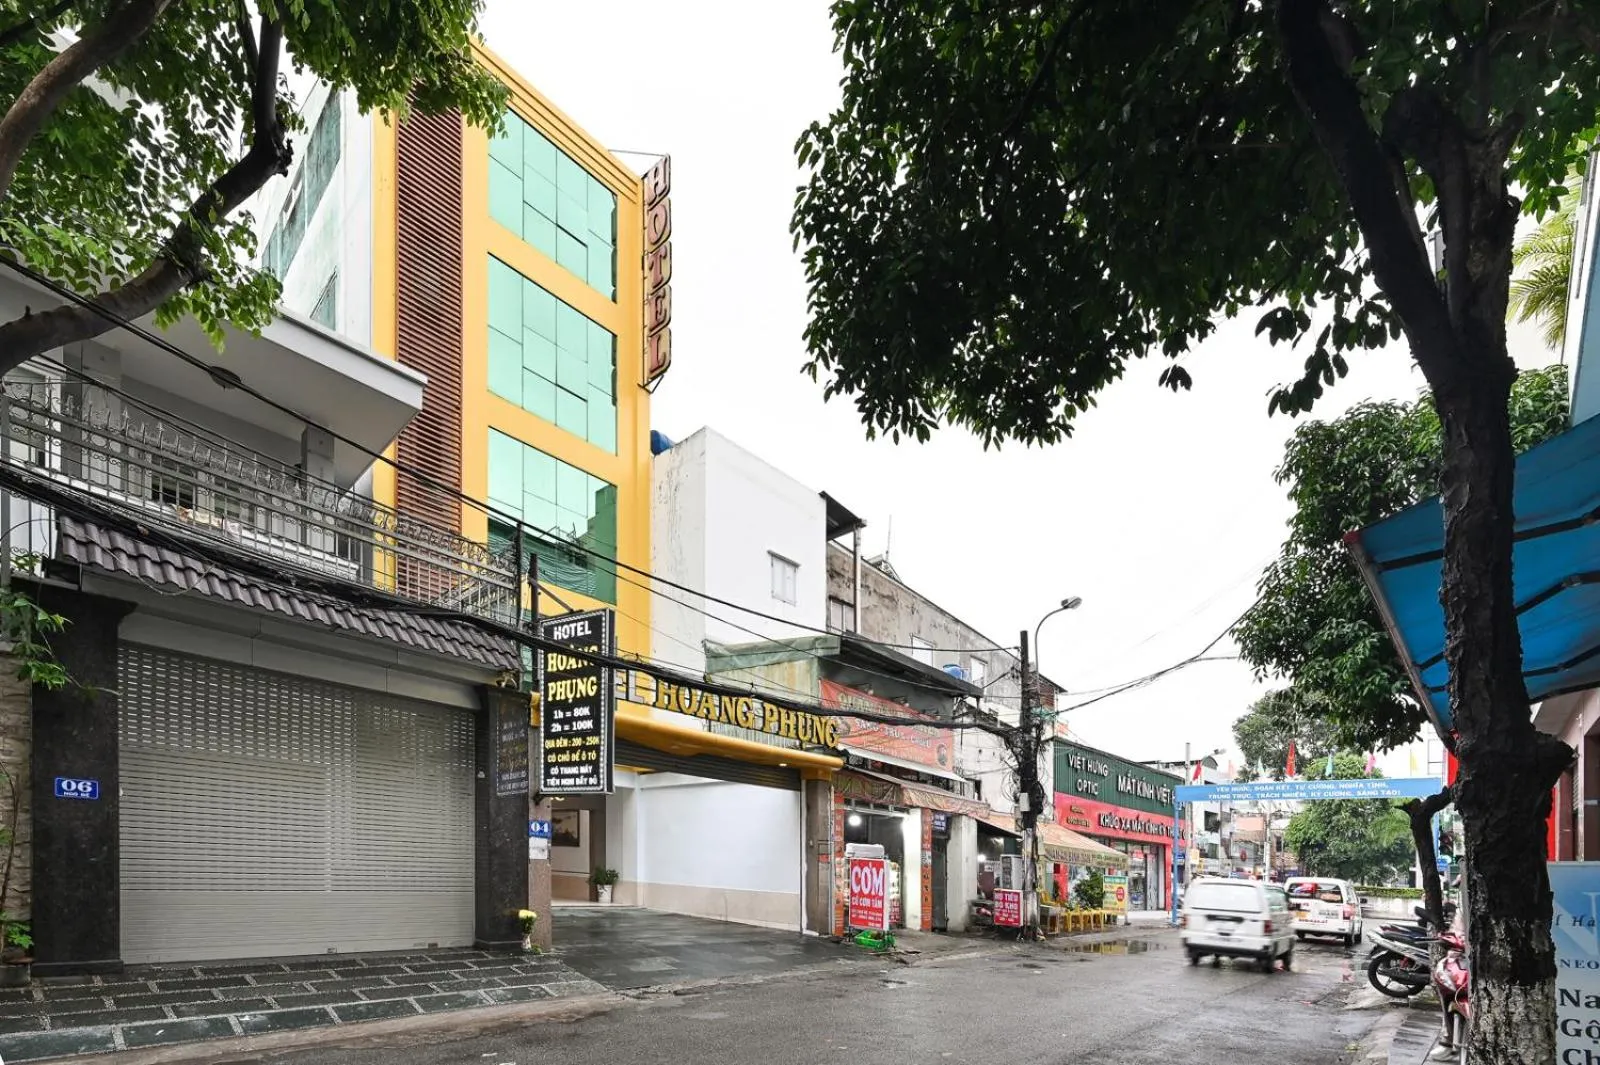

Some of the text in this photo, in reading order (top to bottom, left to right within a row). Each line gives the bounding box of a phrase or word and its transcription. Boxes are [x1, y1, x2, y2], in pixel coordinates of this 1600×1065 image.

[647, 156, 669, 374] HOTEL
[553, 620, 592, 641] HOTEL
[547, 676, 598, 704] PHỤNG
[553, 709, 564, 720] 1h
[573, 706, 591, 718] 80K
[550, 722, 562, 733] 2h
[572, 719, 594, 731] 100K
[1068, 753, 1086, 772] VIỆT
[61, 779, 93, 793] 06
[1076, 778, 1099, 796] OPTIC
[1118, 769, 1136, 795] MẮT
[1136, 777, 1154, 800] KÍNH
[530, 821, 549, 834] 04
